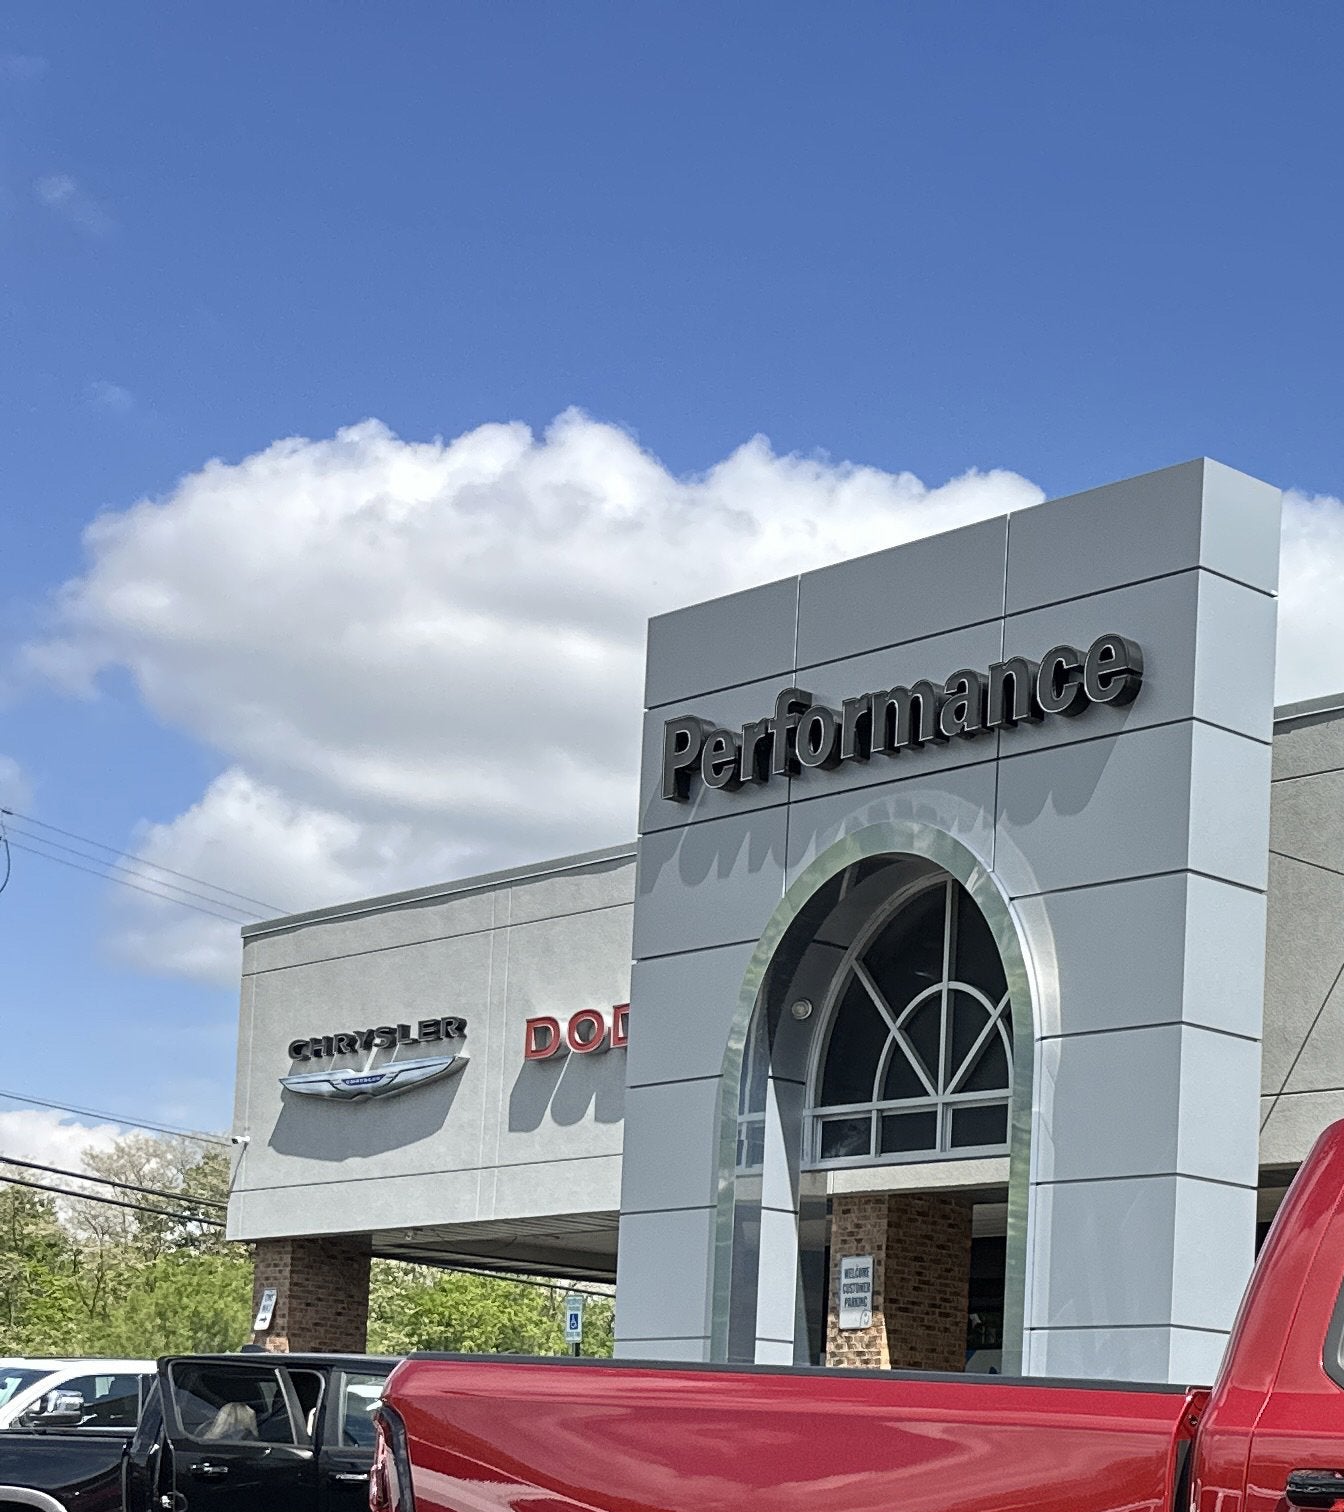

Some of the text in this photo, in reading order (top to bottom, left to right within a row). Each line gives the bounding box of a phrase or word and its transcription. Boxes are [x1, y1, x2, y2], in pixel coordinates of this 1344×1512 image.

[661, 632, 1144, 802] Performance
[288, 1016, 467, 1061] CHRYSLER
[844, 1266, 870, 1279] WELCOME
[843, 1282, 870, 1294] CUSTOMER
[845, 1296, 867, 1308] PARKING
